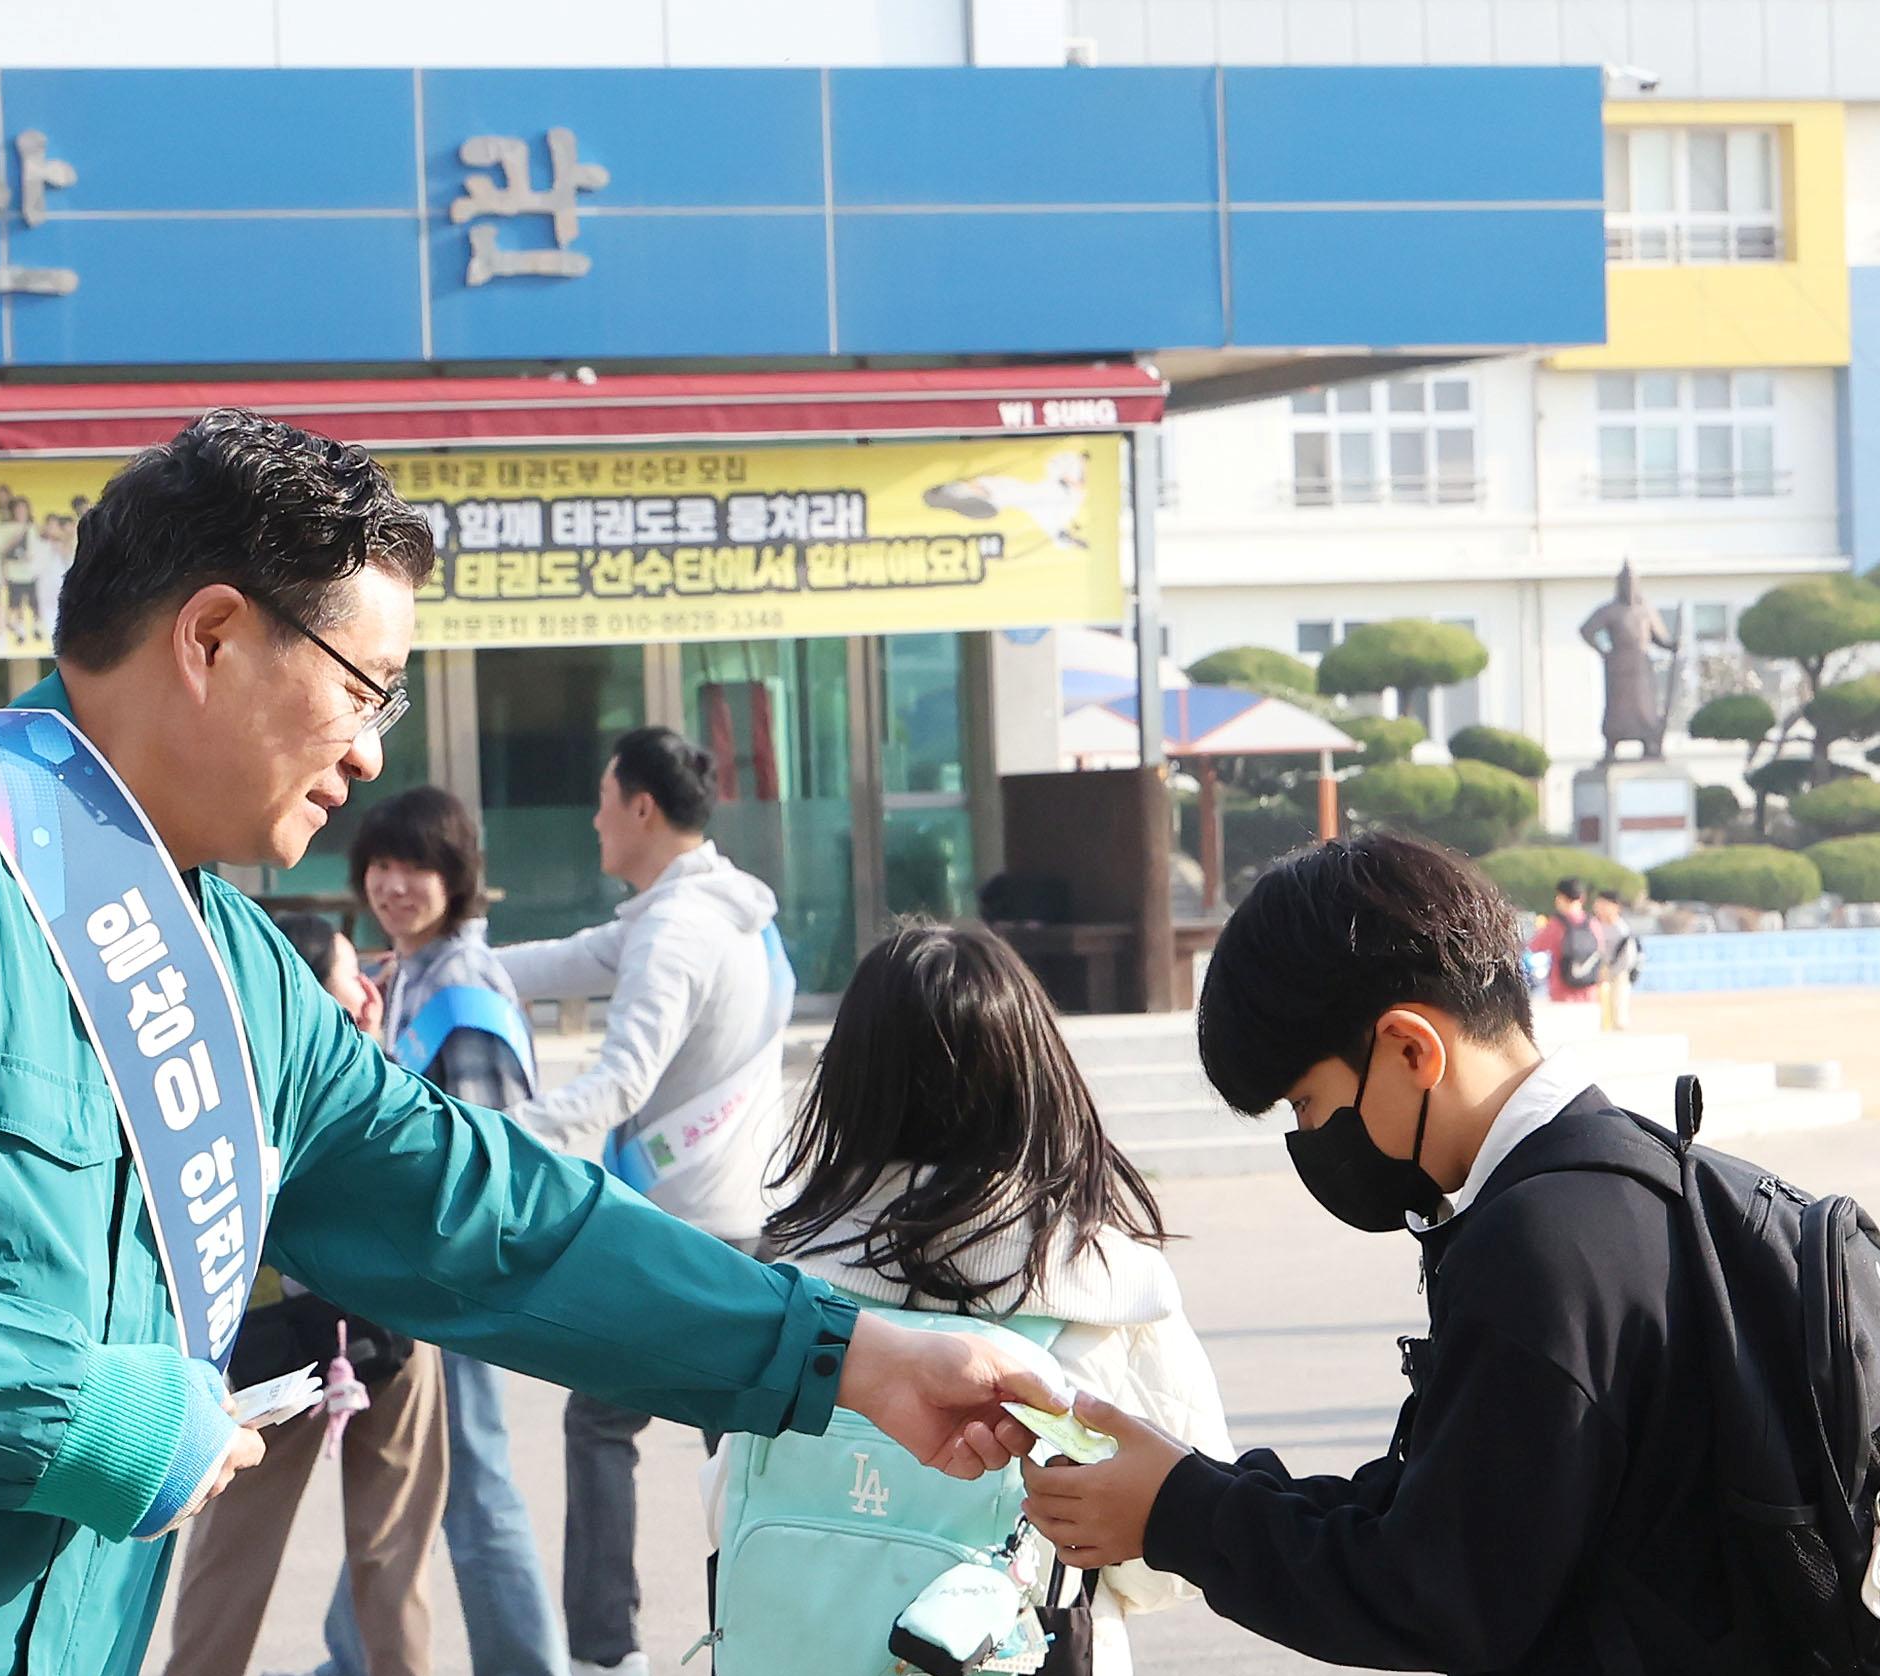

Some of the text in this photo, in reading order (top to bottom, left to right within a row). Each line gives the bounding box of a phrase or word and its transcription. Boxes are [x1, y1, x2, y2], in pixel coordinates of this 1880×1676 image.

[998, 398, 1118, 427] WI SUNG
[455, 497, 543, 550] 함께
[550, 495, 719, 548] 태권도로
[85, 885, 222, 1131] 일상이
[848, 1451, 891, 1517] LA
